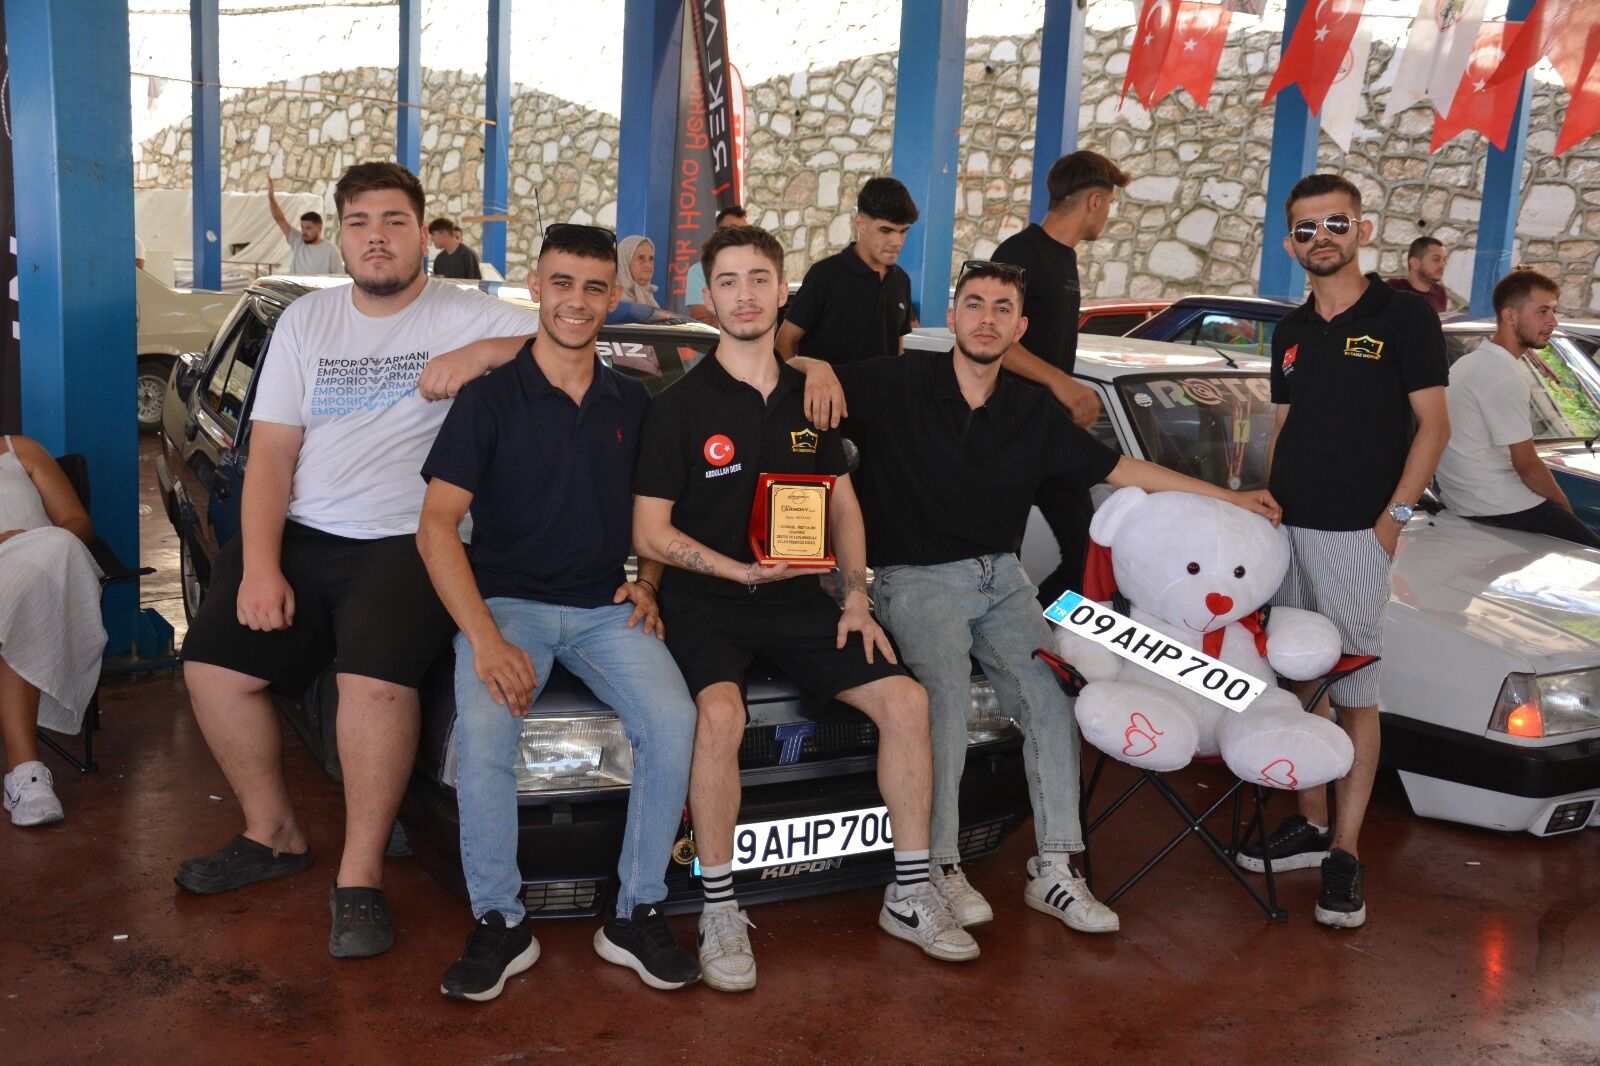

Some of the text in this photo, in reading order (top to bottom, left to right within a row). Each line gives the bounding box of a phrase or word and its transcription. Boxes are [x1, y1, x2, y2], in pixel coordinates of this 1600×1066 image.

[319, 350, 429, 367] EMPORIO ARMANI
[315, 371, 421, 386] EMPORIO ARMAN
[317, 367, 368, 377] EMPORIO
[313, 387, 367, 396] EMPORIO
[311, 407, 357, 416] EMPOR
[1053, 606, 1067, 617] TR
[1069, 605, 1250, 701] 09 AHP 700
[737, 812, 894, 865] 9 AHP 700
[760, 857, 843, 880] KUPON
